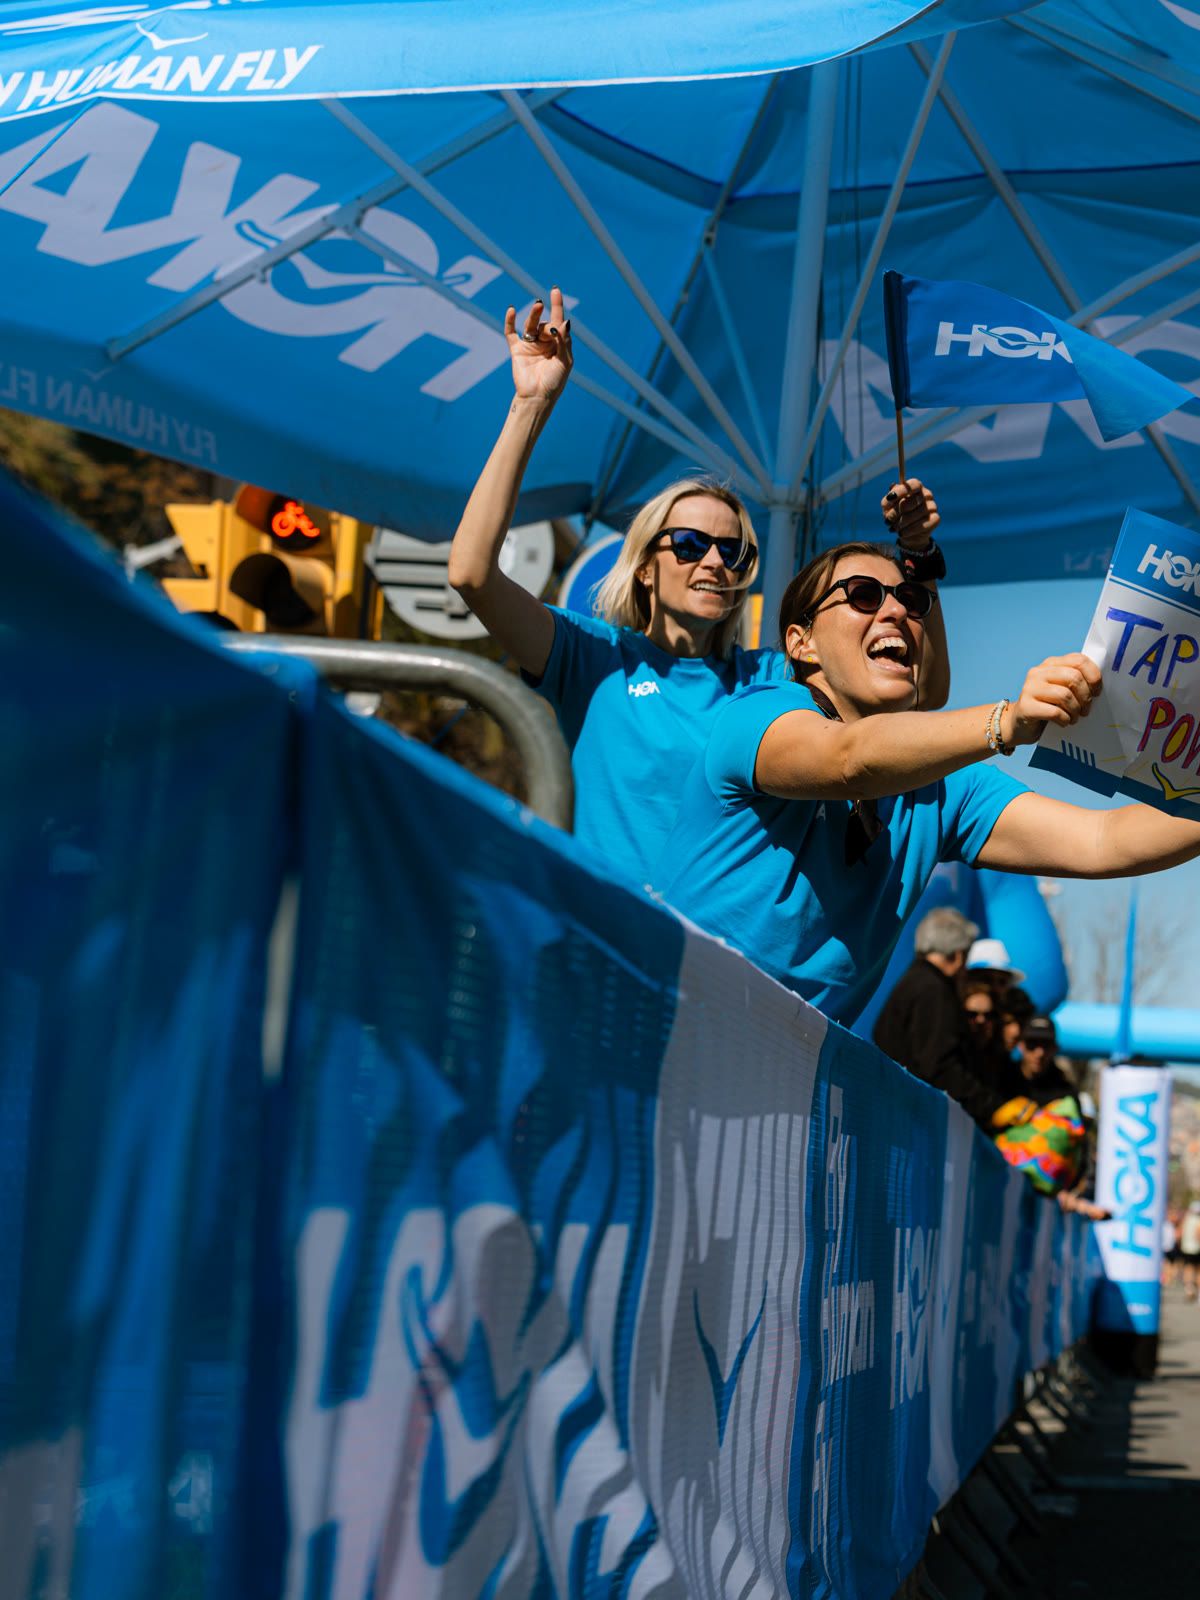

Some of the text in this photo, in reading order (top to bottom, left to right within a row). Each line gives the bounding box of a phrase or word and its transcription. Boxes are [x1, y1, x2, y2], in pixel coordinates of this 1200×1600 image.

[16, 55, 229, 111] HUMAN
[217, 45, 324, 91] FLY
[935, 321, 1074, 364] HOK
[1106, 607, 1200, 688] TAP
[1111, 1092, 1159, 1258] HOKA
